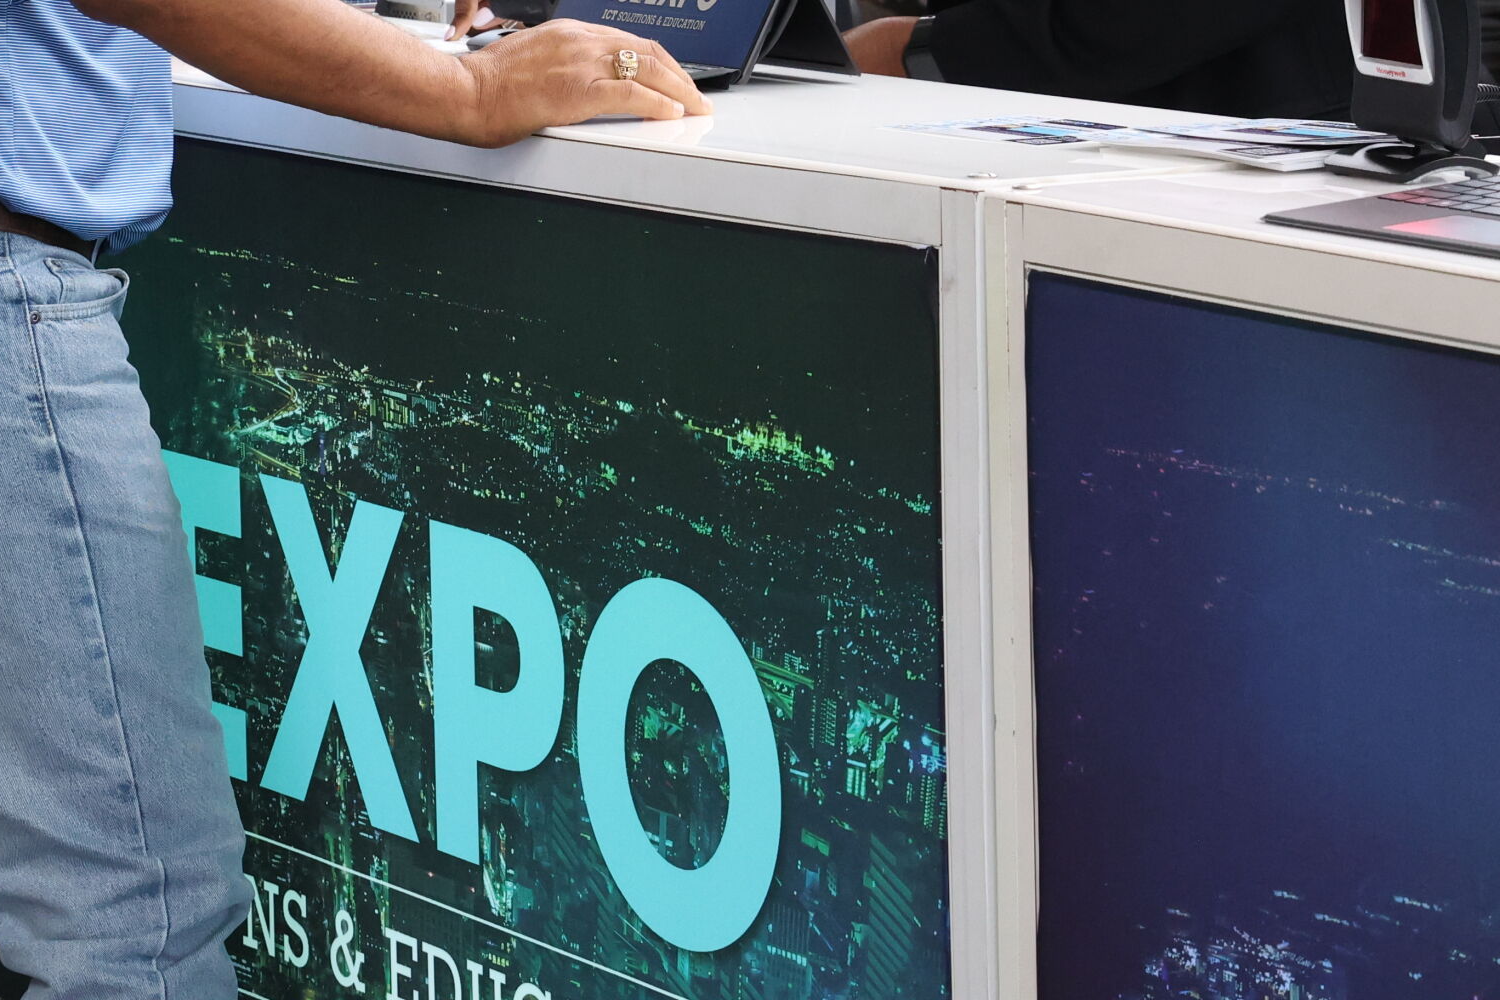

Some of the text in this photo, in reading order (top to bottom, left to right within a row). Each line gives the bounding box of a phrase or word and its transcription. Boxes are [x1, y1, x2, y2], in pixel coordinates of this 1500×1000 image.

[602, 9, 706, 31] ICT SOLUTIONS & EDUCATION
[330, 909, 366, 994] &
